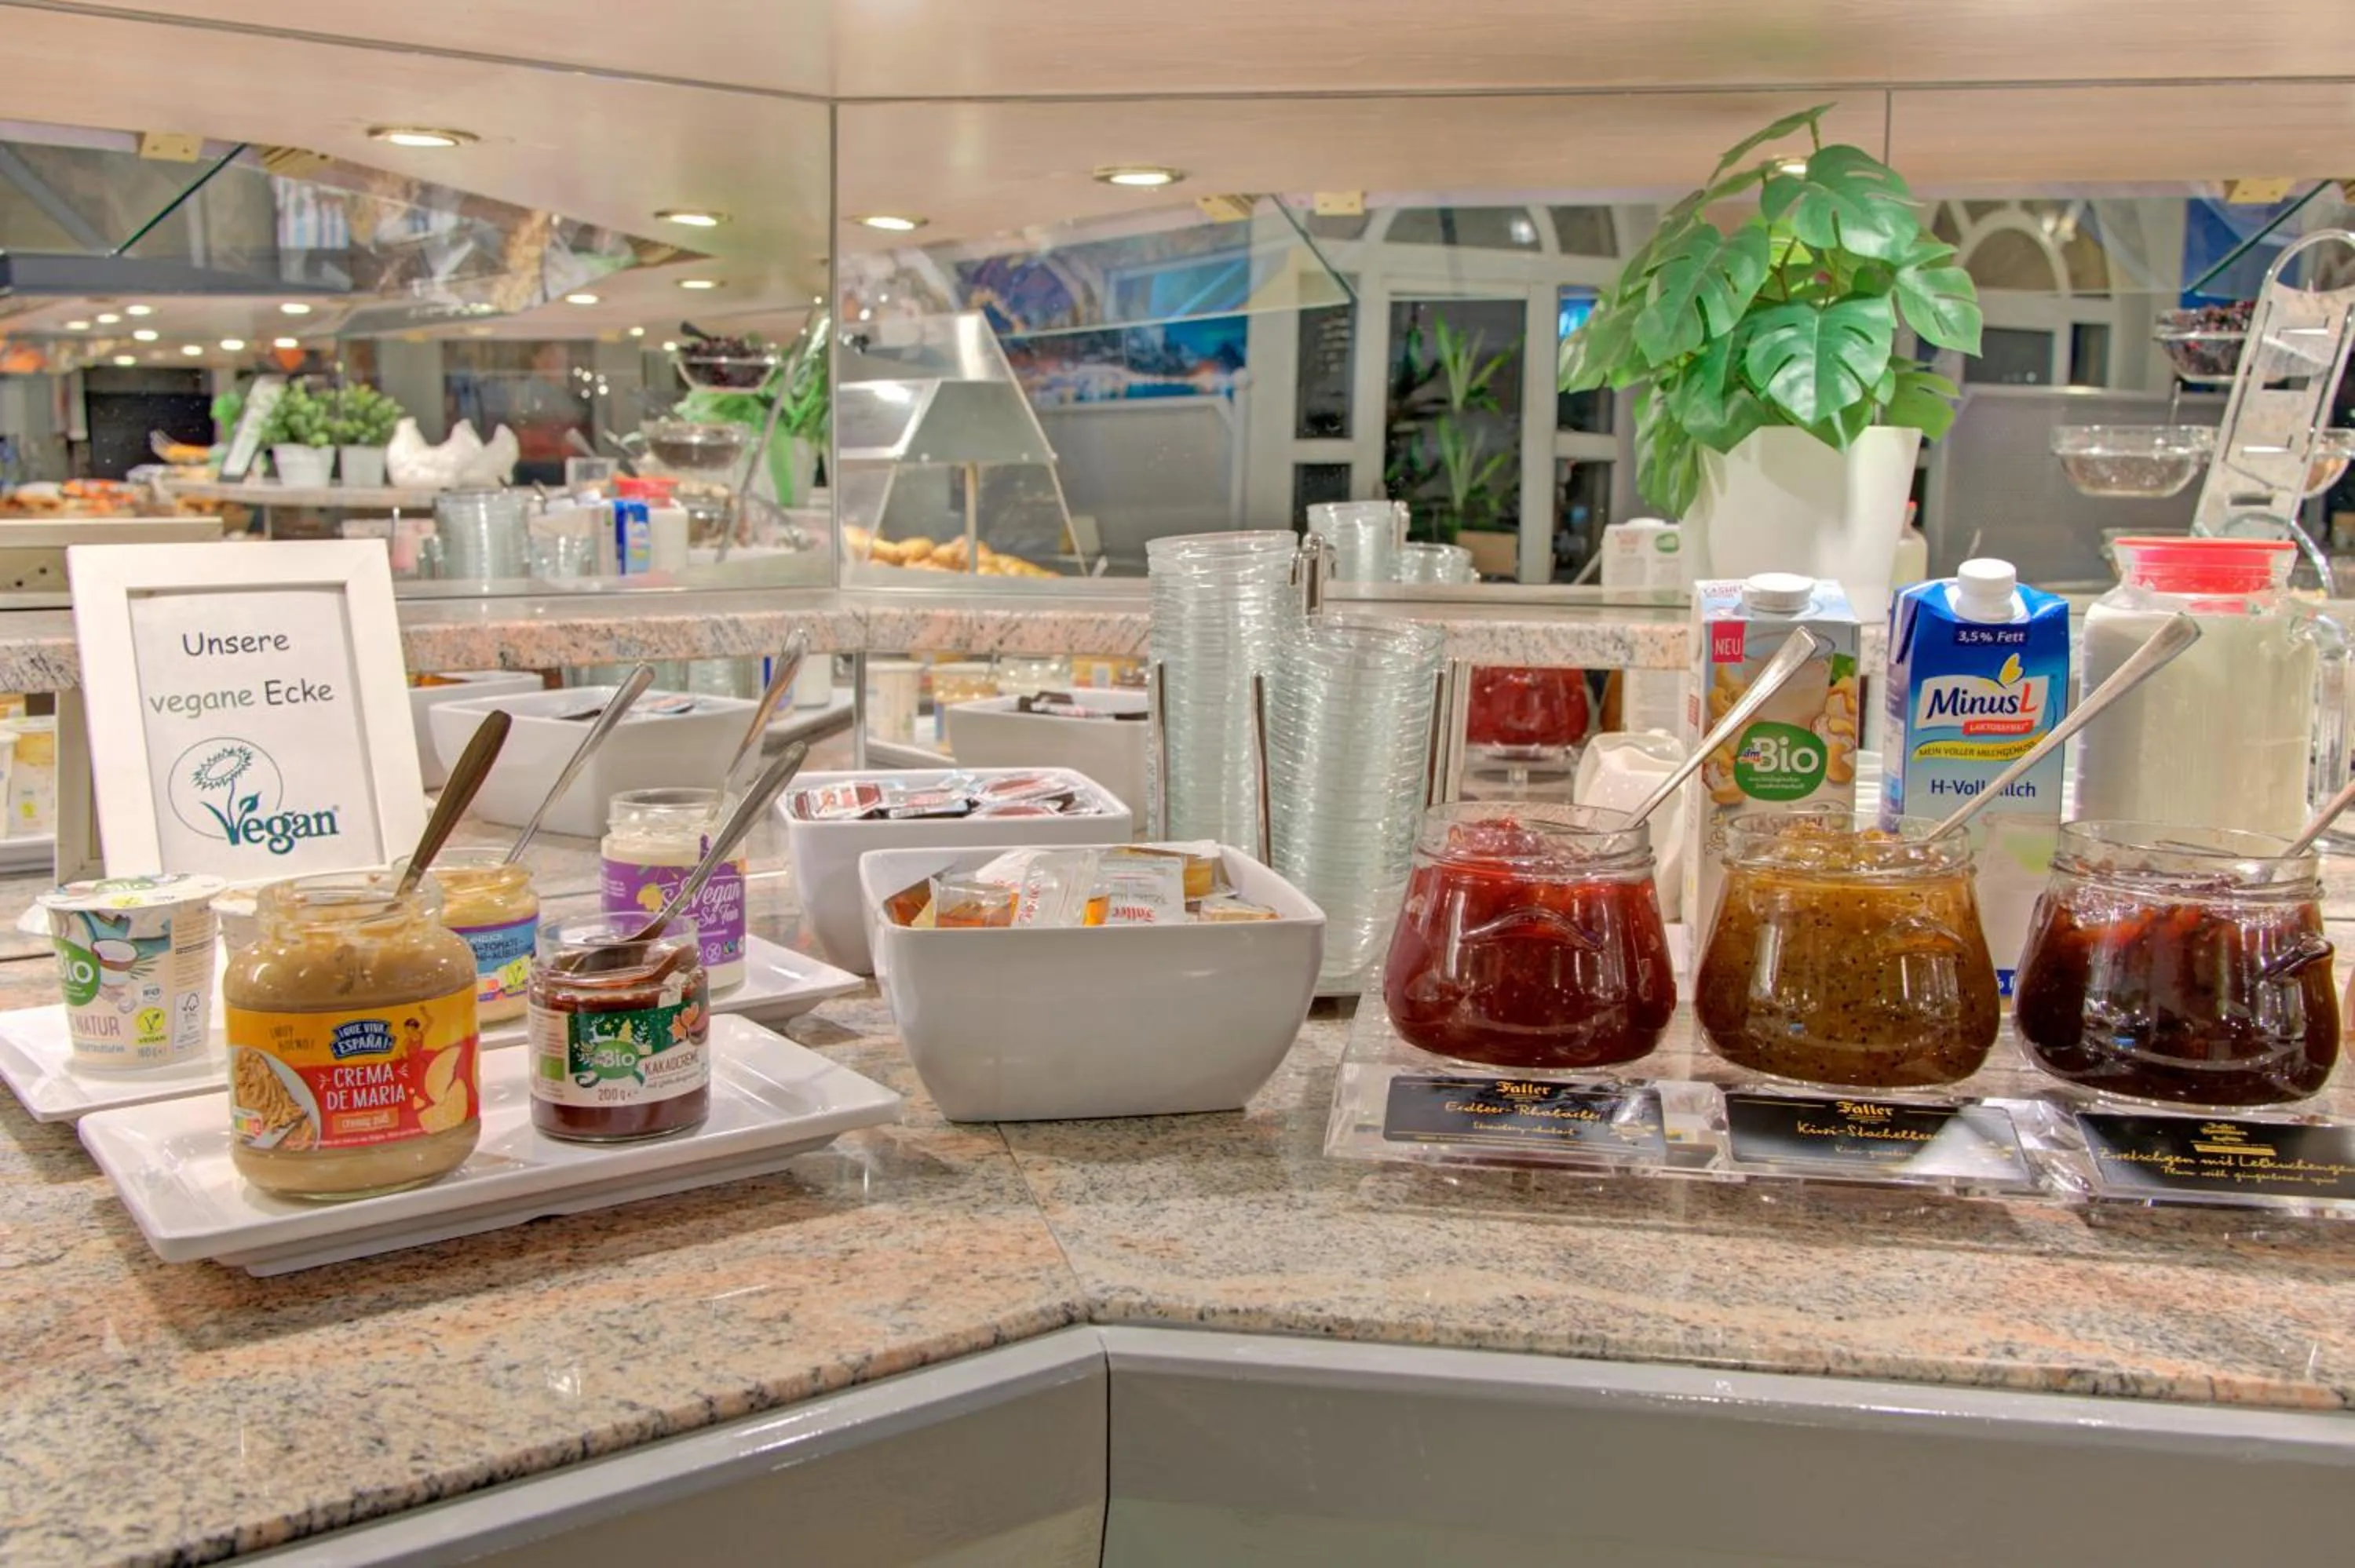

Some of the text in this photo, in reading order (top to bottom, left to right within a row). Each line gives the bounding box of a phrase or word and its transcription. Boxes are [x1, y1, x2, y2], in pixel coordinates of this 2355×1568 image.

[182, 631, 291, 657] Unsere
[1714, 637, 1741, 656] NEU
[1996, 630, 2025, 643] Fett
[148, 678, 335, 720] vegane Ecke
[1926, 682, 2039, 720] MinusL
[1751, 735, 1820, 774] Bio
[199, 791, 341, 856] Vegan
[334, 1063, 395, 1088] CREMA
[1495, 1080, 1551, 1096] Faller
[326, 1082, 406, 1110] DE MARIA
[597, 1088, 619, 1102] 200
[1835, 1099, 1895, 1118] Faller
